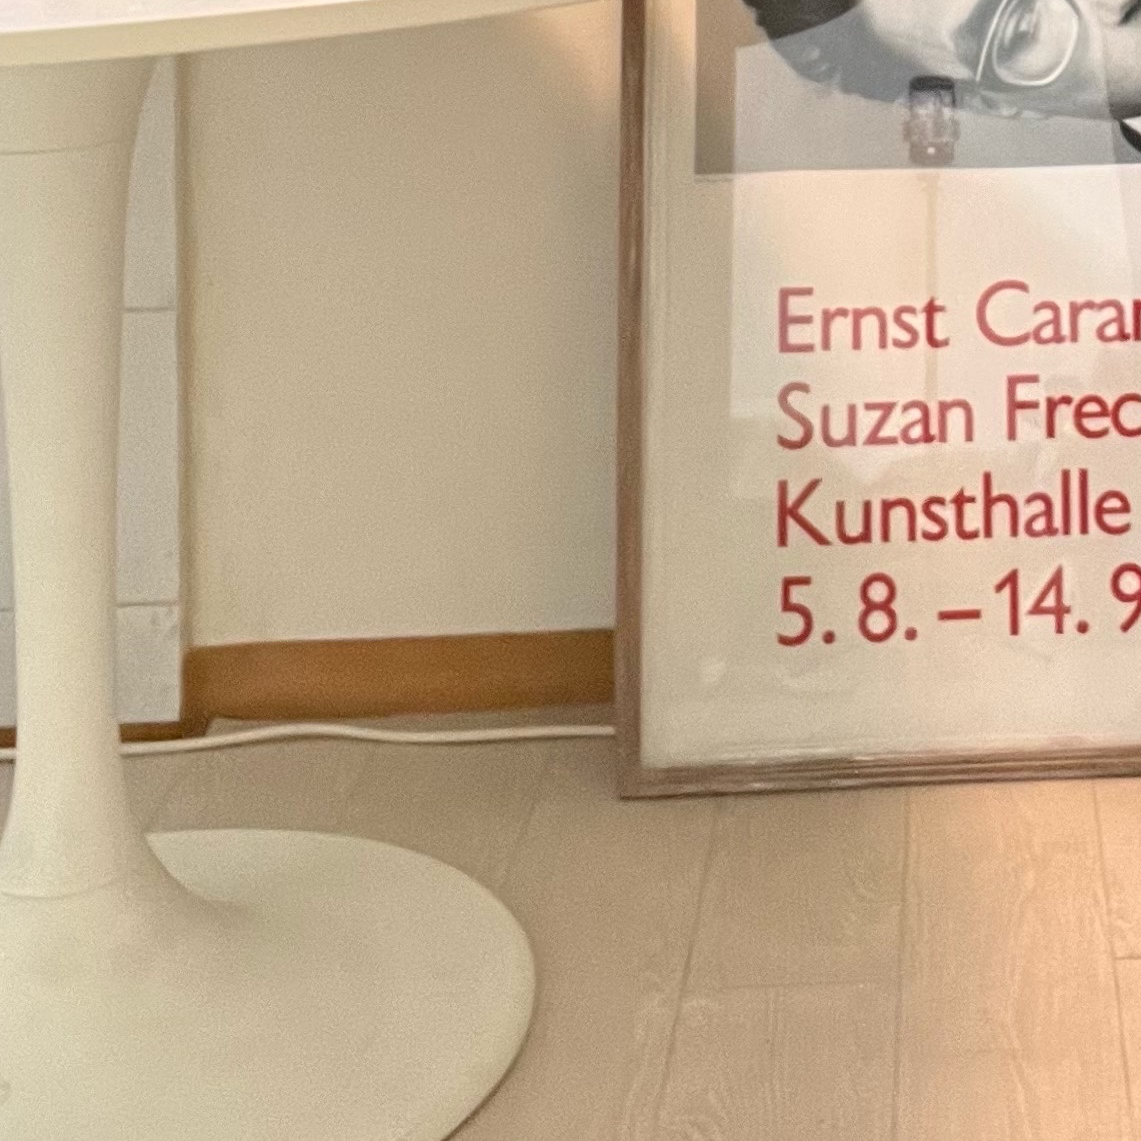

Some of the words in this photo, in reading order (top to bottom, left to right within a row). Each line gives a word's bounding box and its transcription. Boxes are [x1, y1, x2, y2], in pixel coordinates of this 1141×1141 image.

[778, 286, 950, 354] Ernst
[777, 382, 974, 450] Suzan
[777, 467, 1132, 548] Kunsthalle
